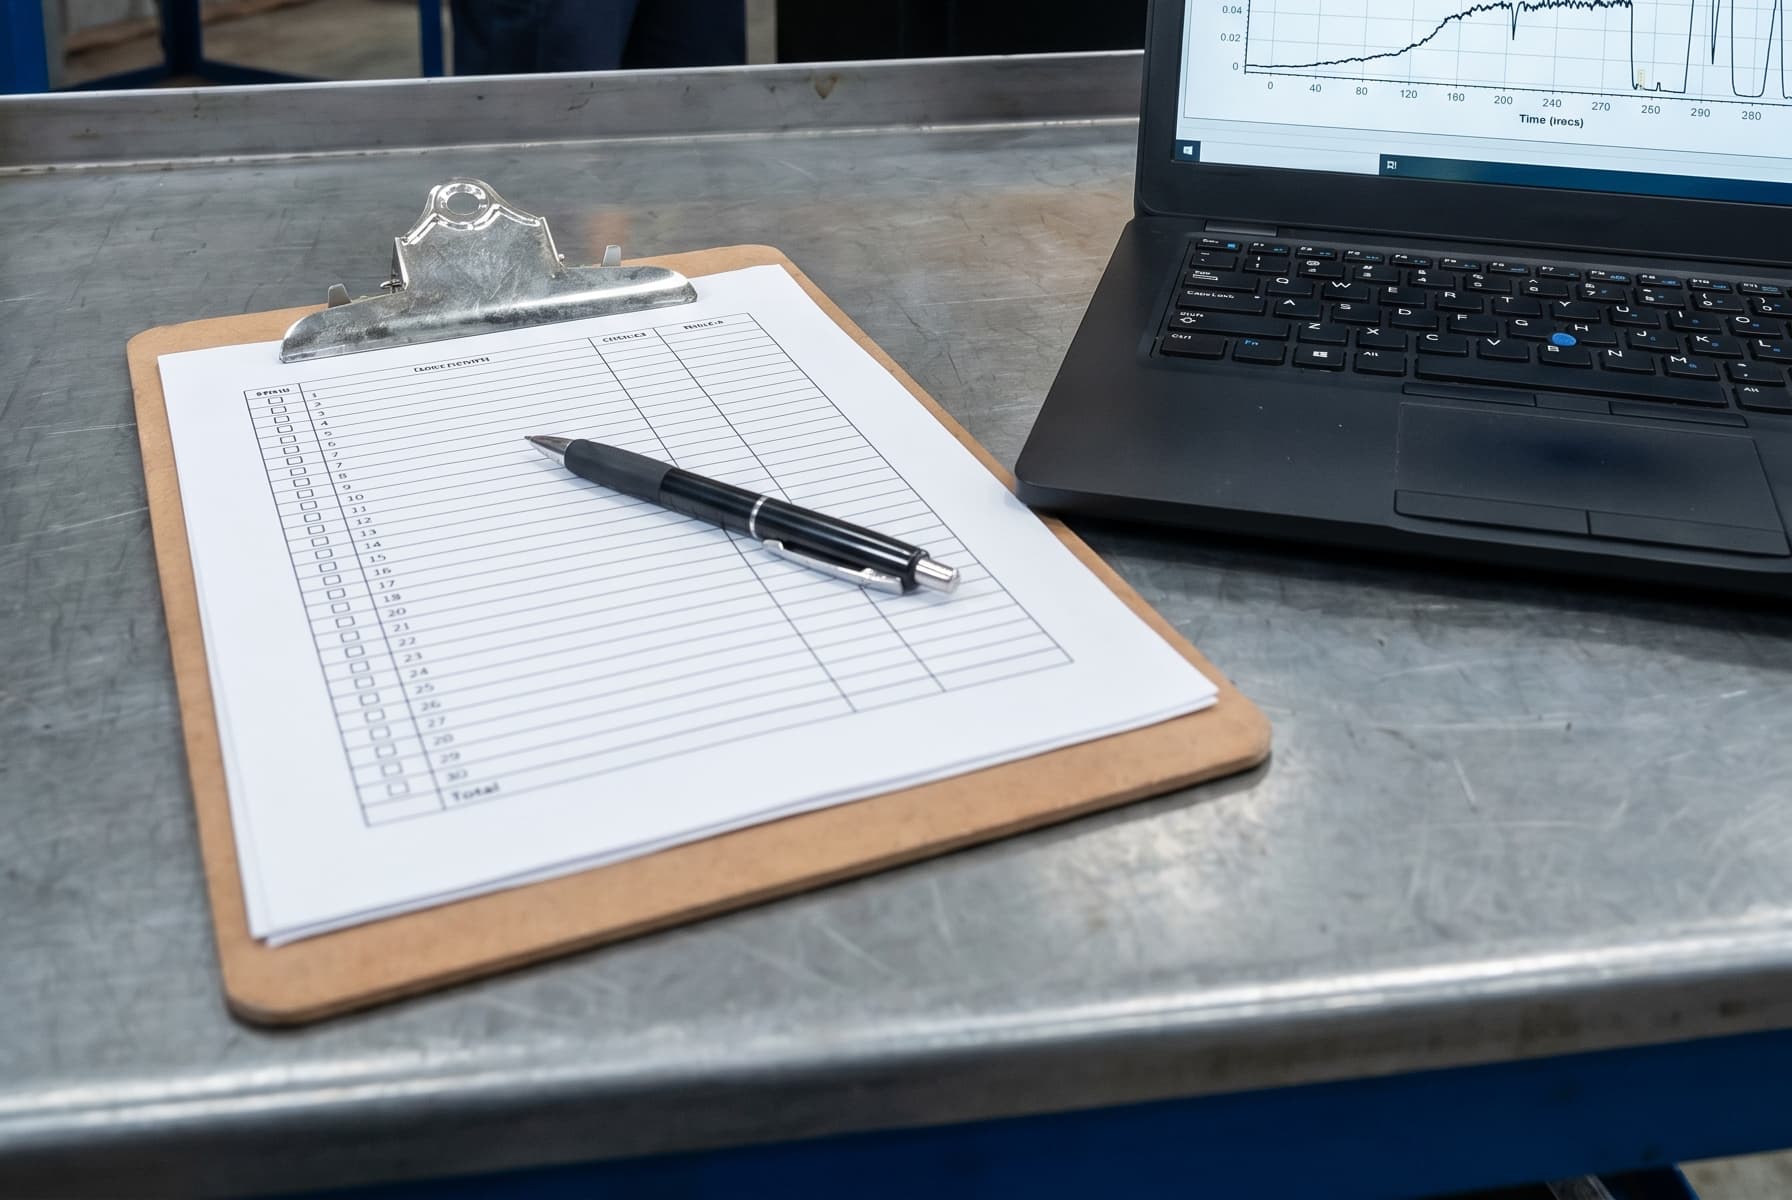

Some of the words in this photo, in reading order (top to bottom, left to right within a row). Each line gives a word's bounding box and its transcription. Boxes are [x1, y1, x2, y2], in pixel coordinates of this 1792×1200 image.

[1222, 5, 1242, 14] 0.04
[1220, 33, 1241, 42] 0.02
[1232, 62, 1239, 70] 0
[1267, 81, 1274, 90] 0
[1309, 83, 1322, 93] 40
[1355, 86, 1368, 96] 80
[1400, 89, 1418, 99] 120
[1447, 92, 1465, 102] 160
[1494, 95, 1513, 105] 200
[1542, 98, 1562, 108] 240
[1591, 101, 1611, 112] 270
[1519, 114, 1547, 125] Time
[1366, 327, 1379, 335] X
[357, 517, 372, 525] 12
[361, 529, 377, 537] 13
[370, 554, 386, 563] 15
[388, 607, 407, 617] 20
[452, 782, 500, 802] Total
